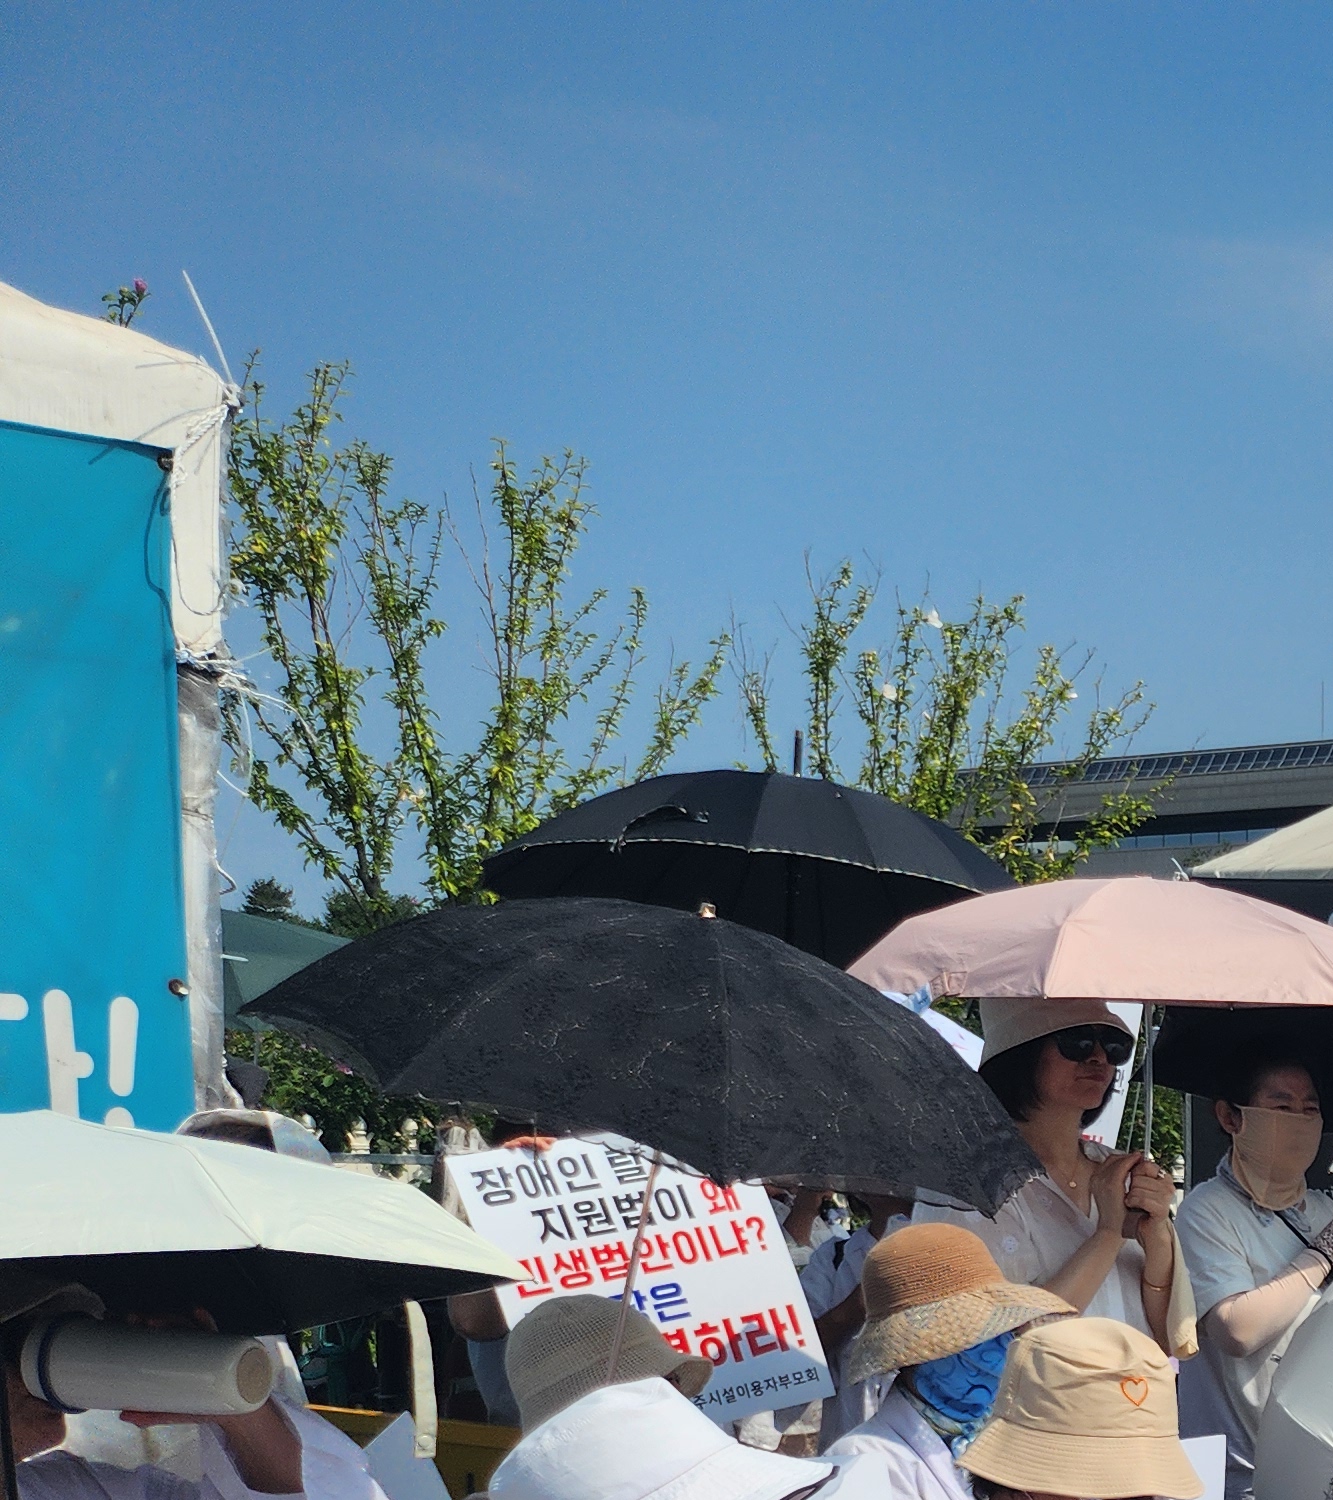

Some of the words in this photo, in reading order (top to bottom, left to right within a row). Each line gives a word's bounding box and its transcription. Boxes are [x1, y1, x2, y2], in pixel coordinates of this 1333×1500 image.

[470, 1150, 598, 1208] 장애인
[530, 1184, 696, 1245] 지원법이
[700, 1177, 742, 1216] 왜
